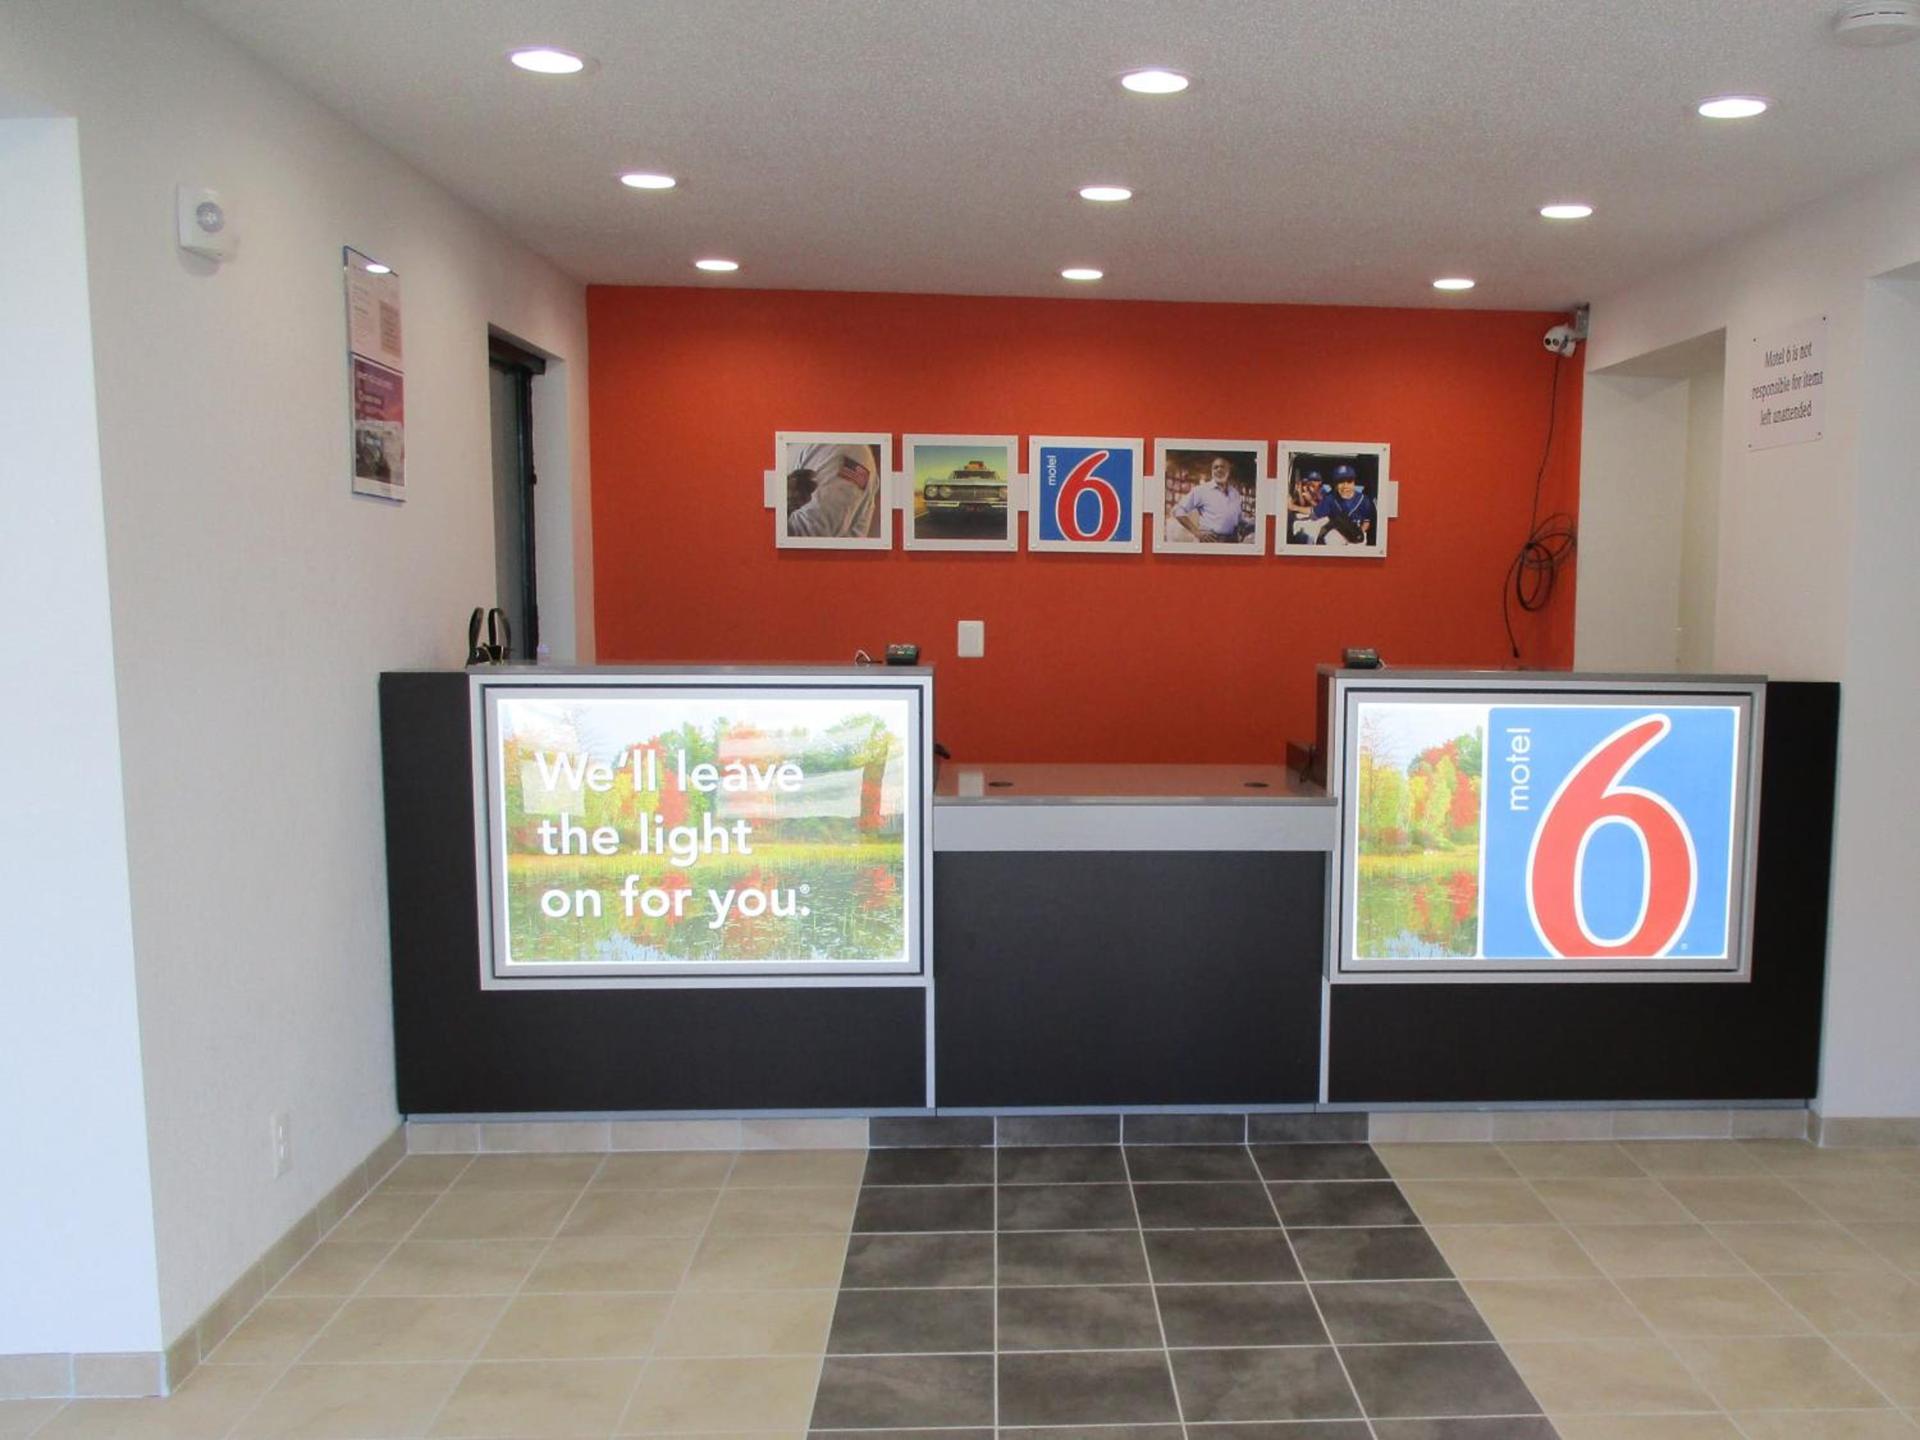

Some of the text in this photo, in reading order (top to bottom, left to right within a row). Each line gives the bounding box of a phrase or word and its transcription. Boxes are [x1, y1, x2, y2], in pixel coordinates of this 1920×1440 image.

[1765, 341, 1813, 367] Motel 6 is not
[1751, 370, 1824, 401] responsible for items
[1760, 400, 1812, 425] left unattended
[1047, 450, 1121, 541] motel 6
[534, 748, 804, 792] We'll leave
[537, 812, 753, 868] the light
[1506, 713, 1698, 958] motel 6
[540, 886, 601, 918] on
[620, 874, 692, 918] for
